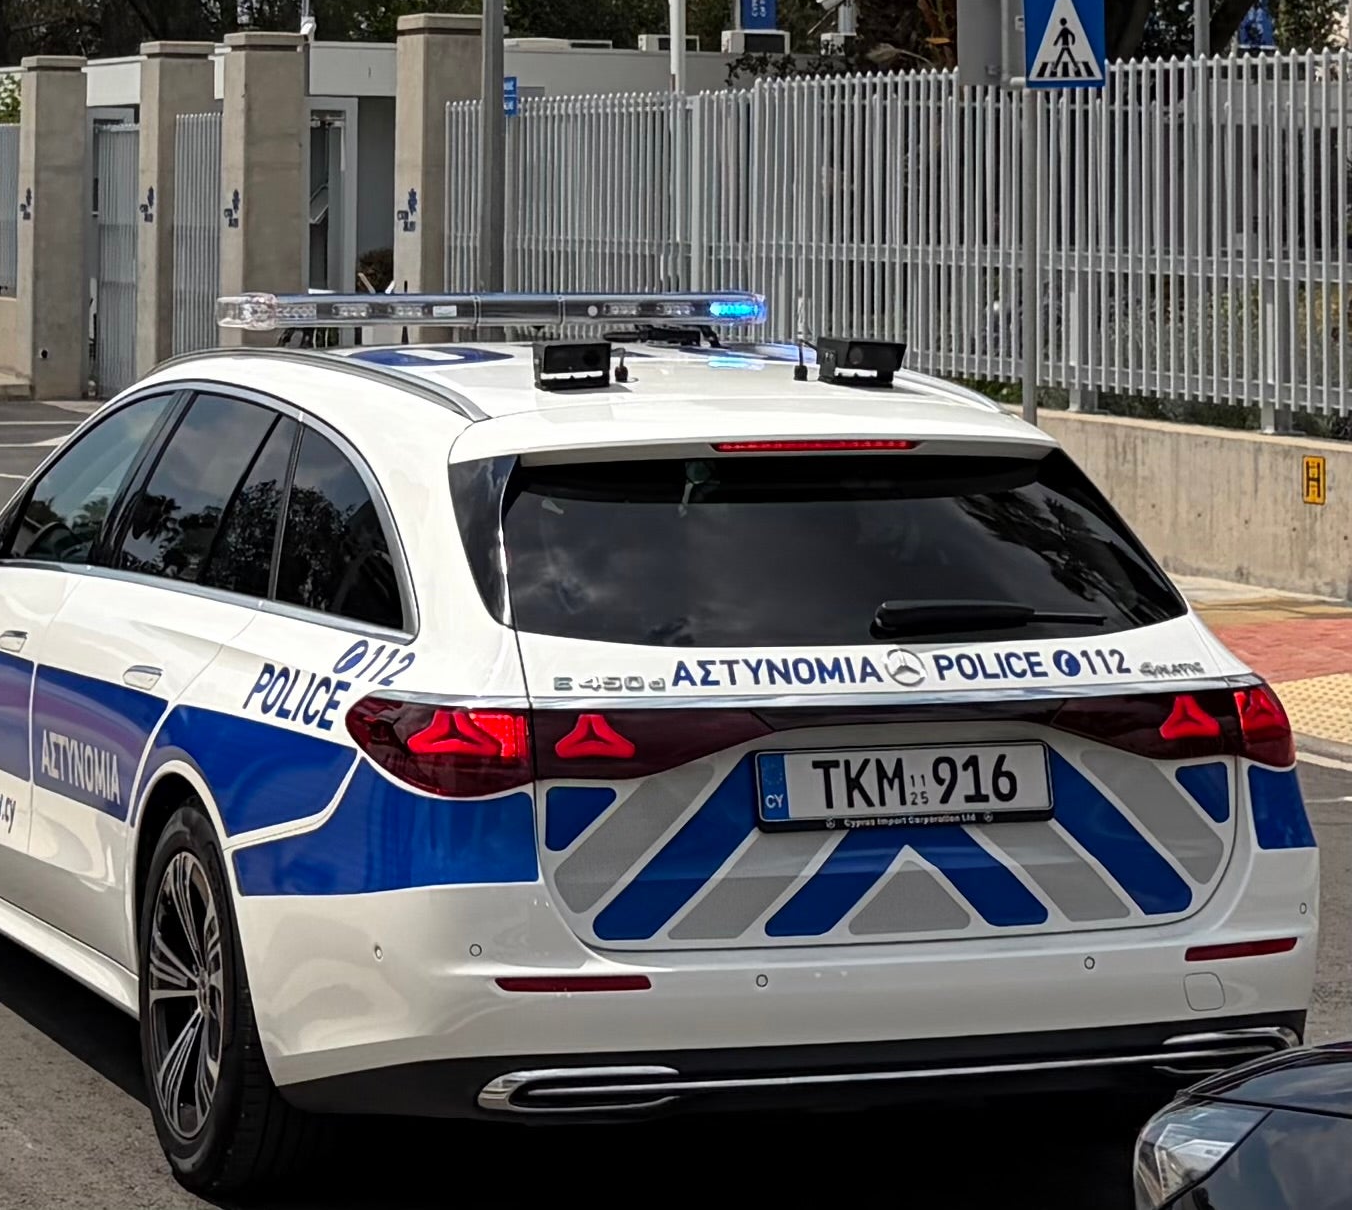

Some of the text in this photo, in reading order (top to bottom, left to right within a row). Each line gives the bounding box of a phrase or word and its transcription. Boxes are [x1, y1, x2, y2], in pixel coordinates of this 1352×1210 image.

[354, 644, 416, 687] 112
[671, 656, 884, 687] ΑΣΤΥΝΟΜΙΑ
[932, 649, 1132, 681] POLICE 112
[242, 662, 352, 731] POLICE
[41, 729, 121, 806] ΑΣΤΥΝΟΜΙΑ
[812, 753, 1018, 809] TKM 916
[764, 793, 785, 809] CY
[909, 791, 930, 806] 25
[843, 818, 876, 828] Cyprus
